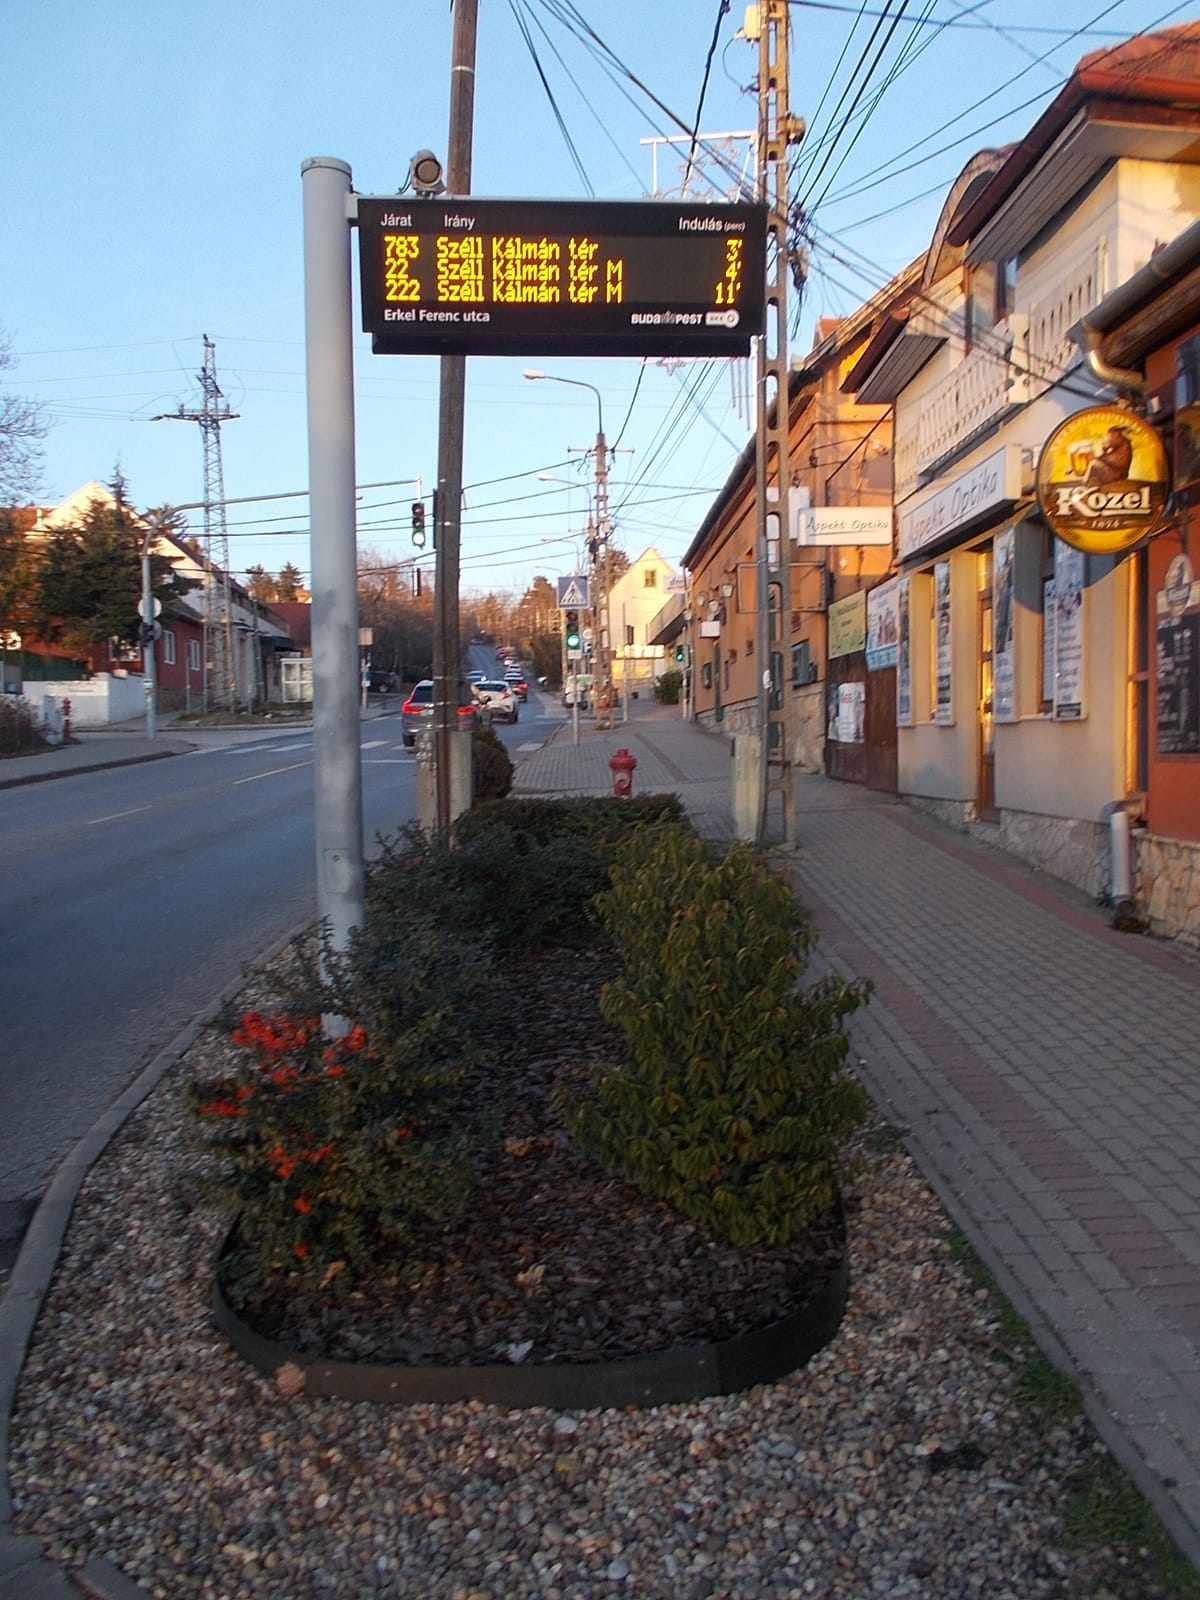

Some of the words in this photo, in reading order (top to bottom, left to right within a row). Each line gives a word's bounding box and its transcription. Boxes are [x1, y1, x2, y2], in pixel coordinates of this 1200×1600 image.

[381, 213, 412, 227] Járat
[444, 214, 475, 230] Irány
[679, 217, 723, 231] Indulás
[384, 236, 420, 258] 783
[436, 236, 484, 259] Széll
[492, 236, 560, 260] Kálmán
[569, 237, 599, 260] tér
[385, 258, 409, 279] 22
[437, 258, 484, 280] Széll
[492, 258, 560, 281] Kálmán
[568, 260, 598, 281] tér
[606, 259, 623, 281] M
[385, 279, 421, 301] 222
[437, 279, 485, 302] Széll
[492, 280, 560, 303] Kálmán
[568, 281, 598, 304] tér
[606, 281, 623, 304] M
[384, 309, 416, 321] Erkel
[419, 309, 460, 322] Ferenc
[463, 310, 490, 323] utca
[1055, 486, 1152, 517] Kozel
[851, 519, 889, 532] Optika
